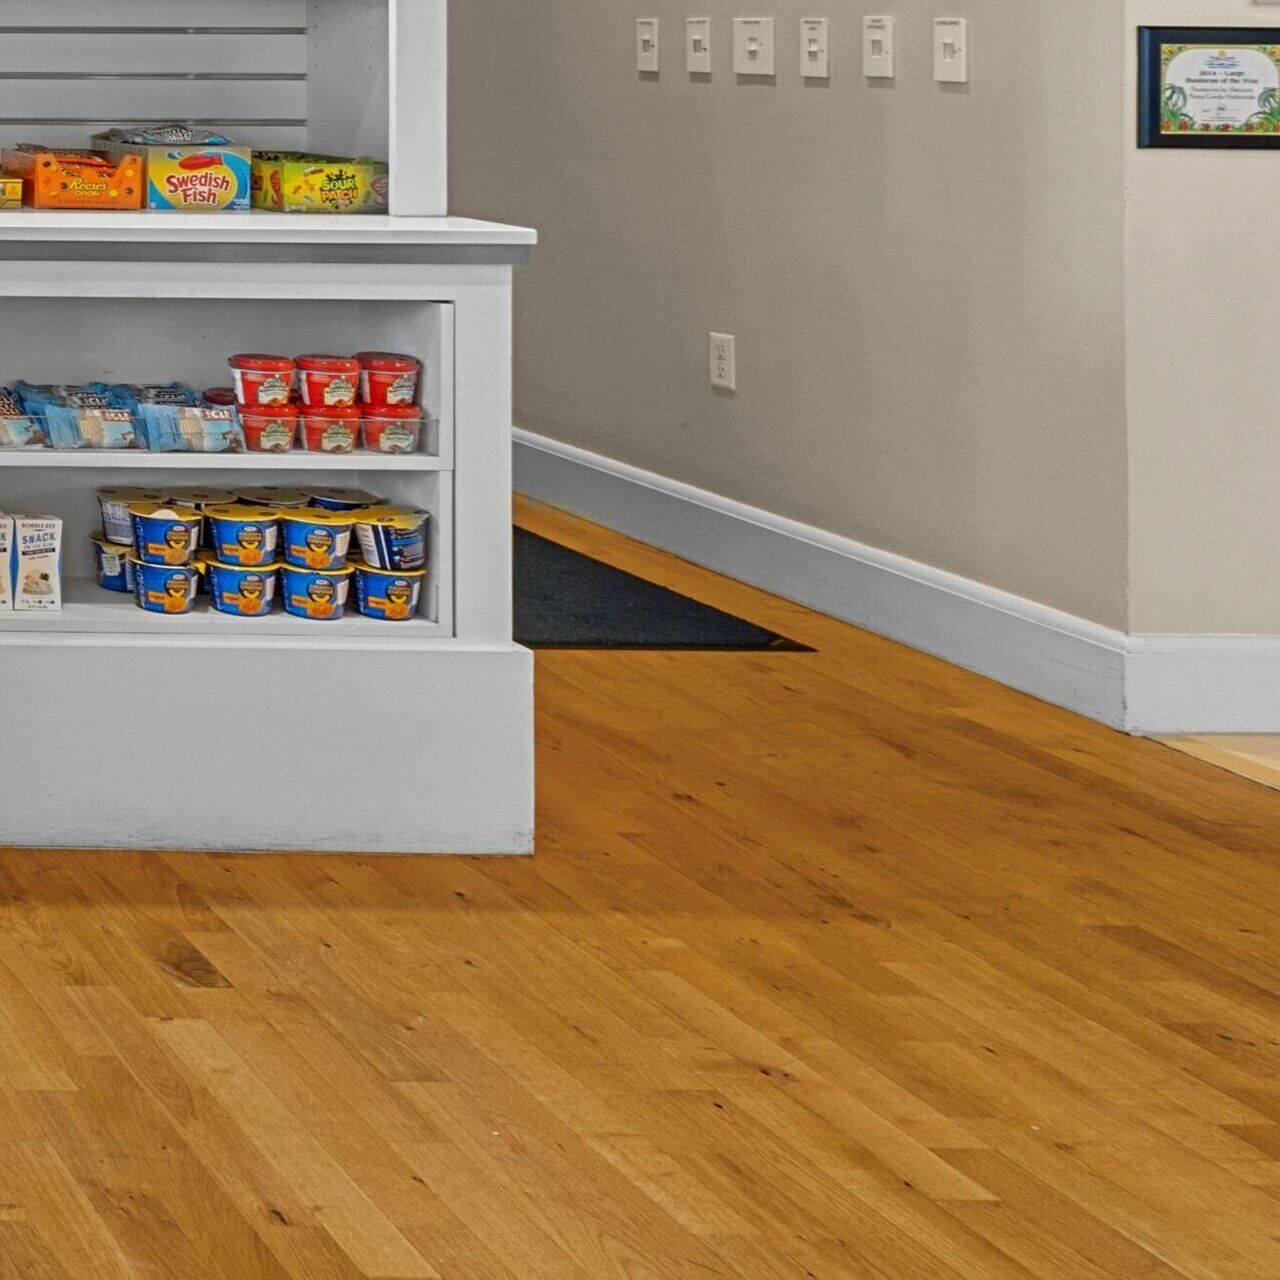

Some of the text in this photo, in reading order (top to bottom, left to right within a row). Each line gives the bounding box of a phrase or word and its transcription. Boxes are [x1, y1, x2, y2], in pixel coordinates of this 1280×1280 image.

[70, 179, 107, 190] Reese's
[165, 172, 231, 194] Swedish
[322, 179, 355, 190] SOUR
[181, 187, 218, 205] Fish
[321, 189, 358, 200] PATCH
[22, 532, 56, 545] SNACK
